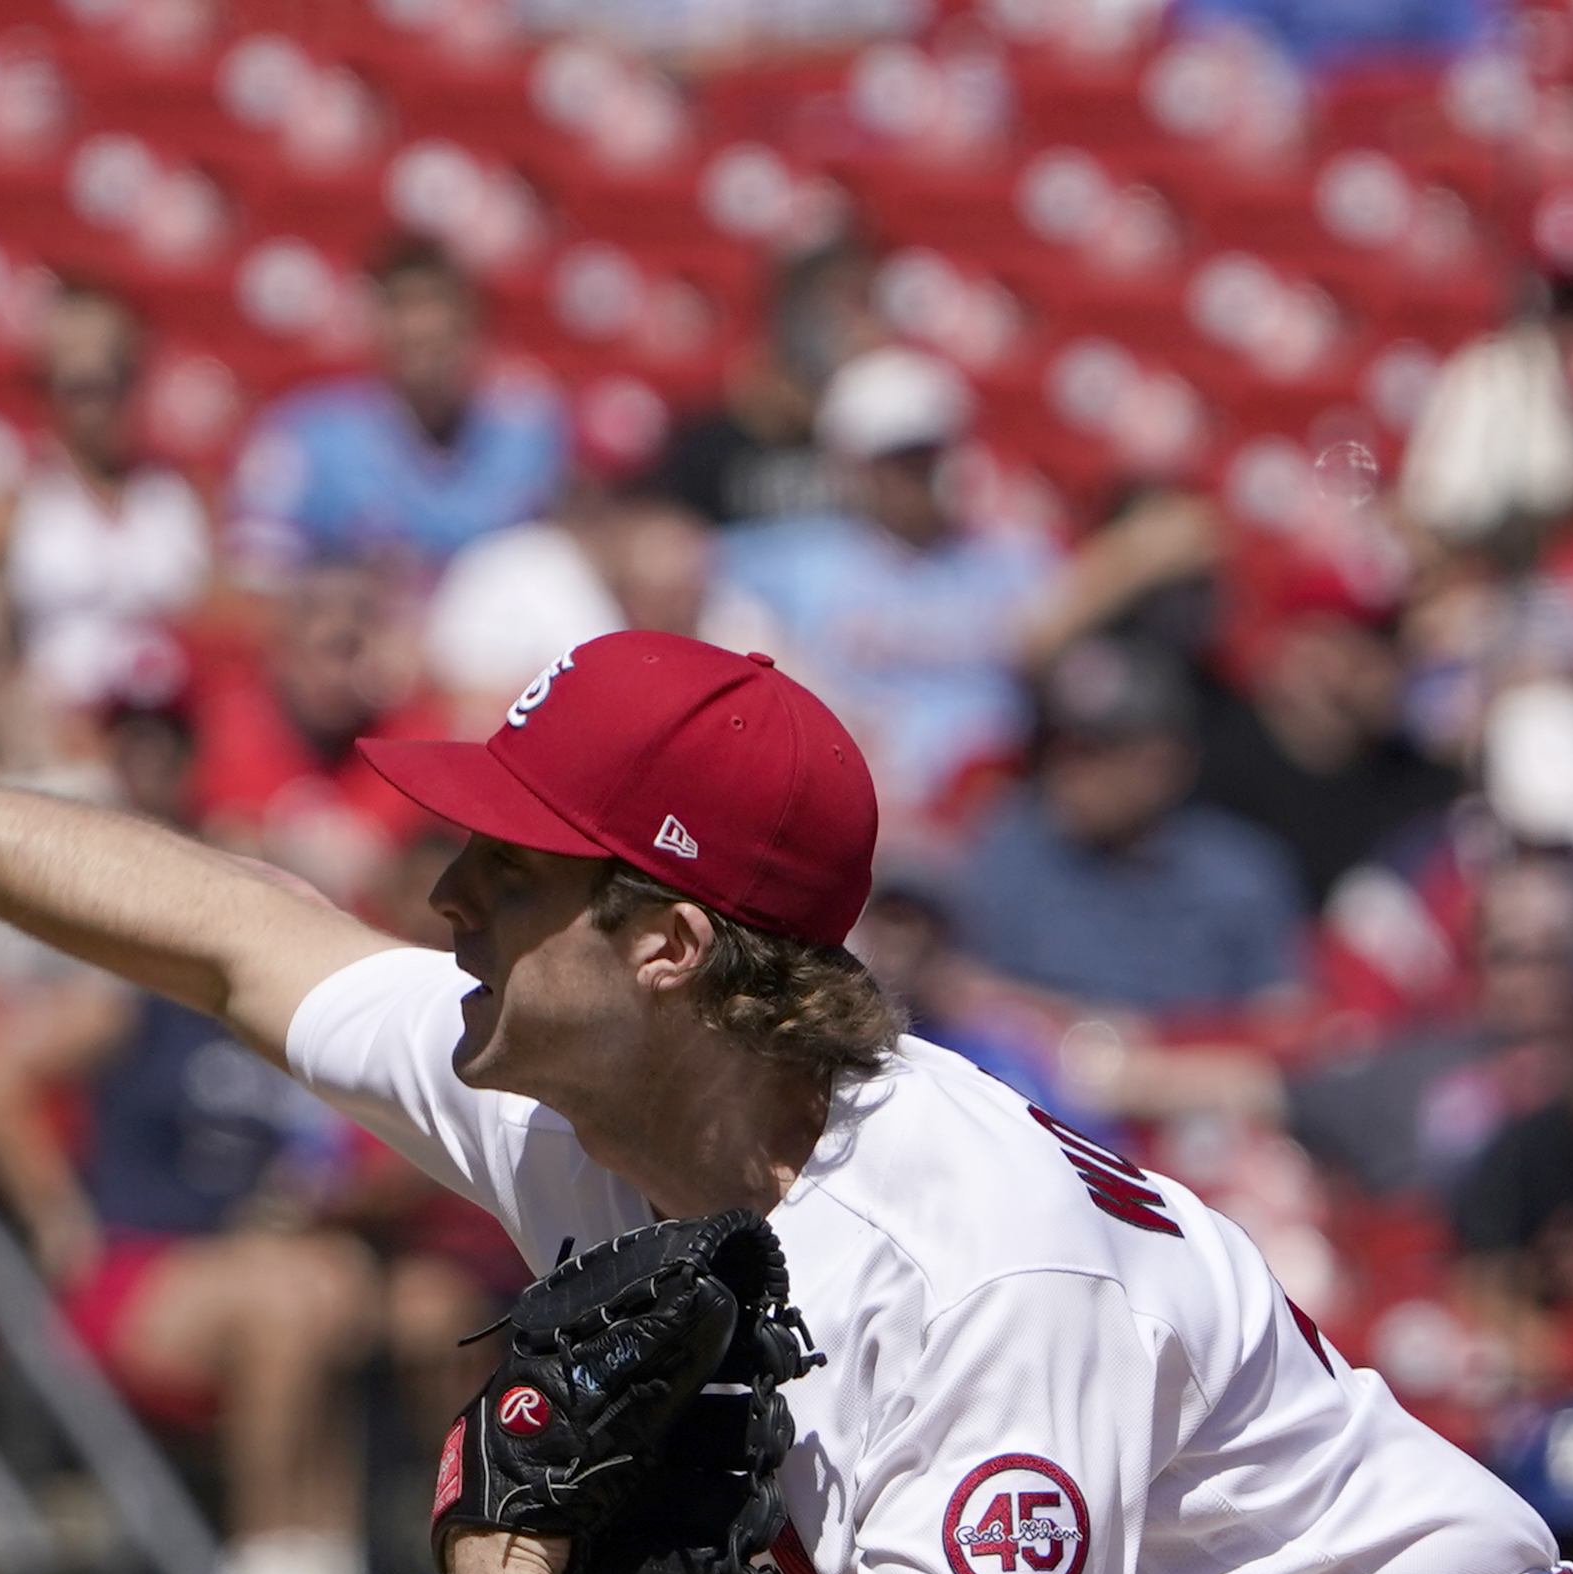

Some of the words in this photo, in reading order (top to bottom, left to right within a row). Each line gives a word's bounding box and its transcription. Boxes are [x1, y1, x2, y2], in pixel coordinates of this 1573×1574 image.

[501, 1389, 541, 1427] R
[955, 1524, 1005, 1545] Bob
[971, 1491, 1061, 1571] 45
